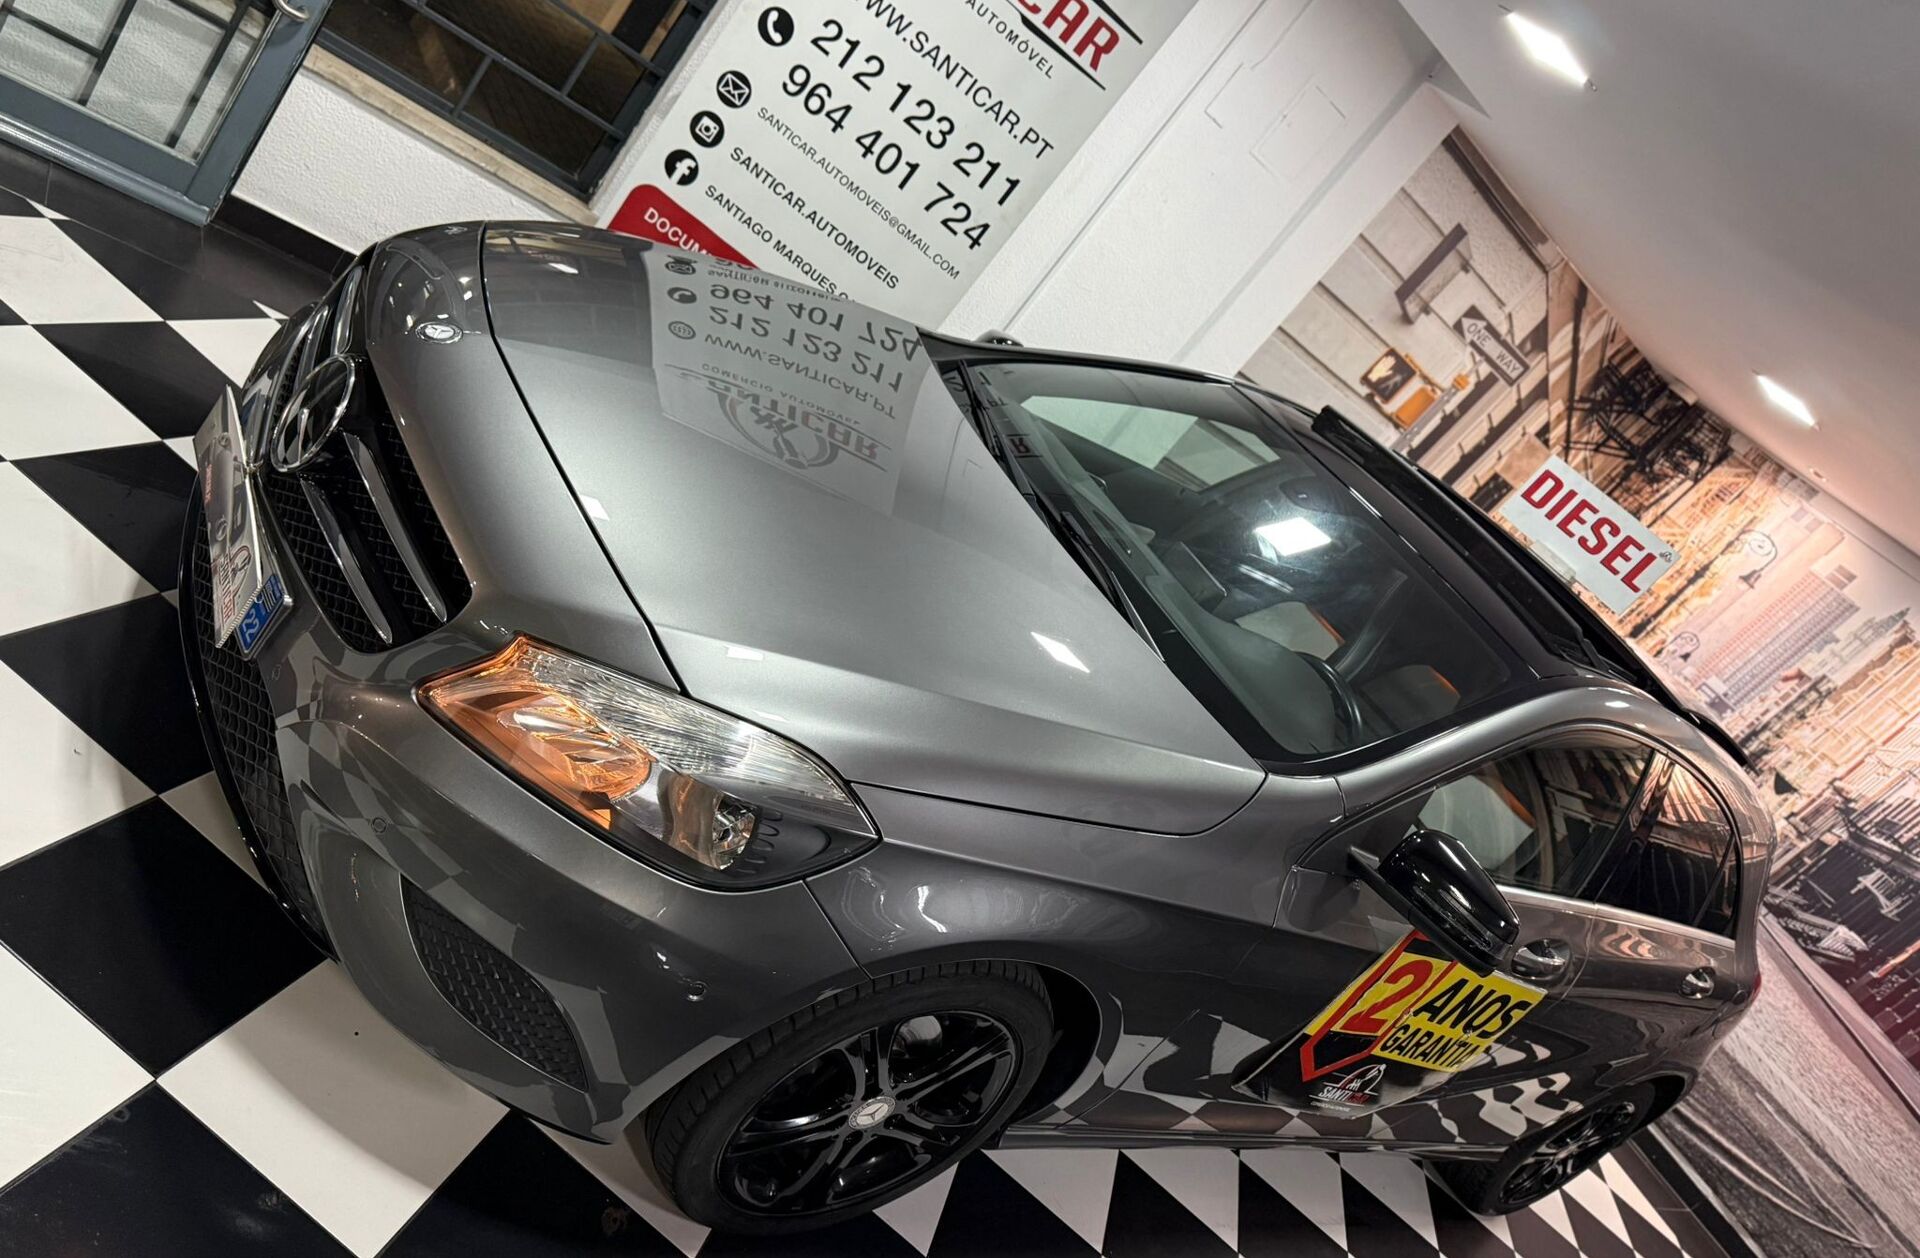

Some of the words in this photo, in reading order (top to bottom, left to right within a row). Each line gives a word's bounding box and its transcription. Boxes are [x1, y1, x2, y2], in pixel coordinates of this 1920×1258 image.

[782, 64, 853, 133] 964
[855, 129, 920, 191] 401
[924, 181, 990, 250] 724
[811, 19, 885, 92] 212
[889, 82, 955, 149] 123
[953, 142, 1021, 206] 211
[705, 184, 773, 243] SANTIAGO
[773, 239, 837, 294] MARQUES
[730, 147, 899, 290] SANTICAR.AUTOMOVEIS
[757, 107, 961, 280] SANTICAR.AUTOMOVEIS@GMAIL.COM
[1466, 322, 1491, 347] ONE
[1497, 350, 1521, 374] WAY
[1520, 469, 1656, 593] DIESEL
[1339, 959, 1433, 1034] 2
[1412, 978, 1534, 1039] ANOS
